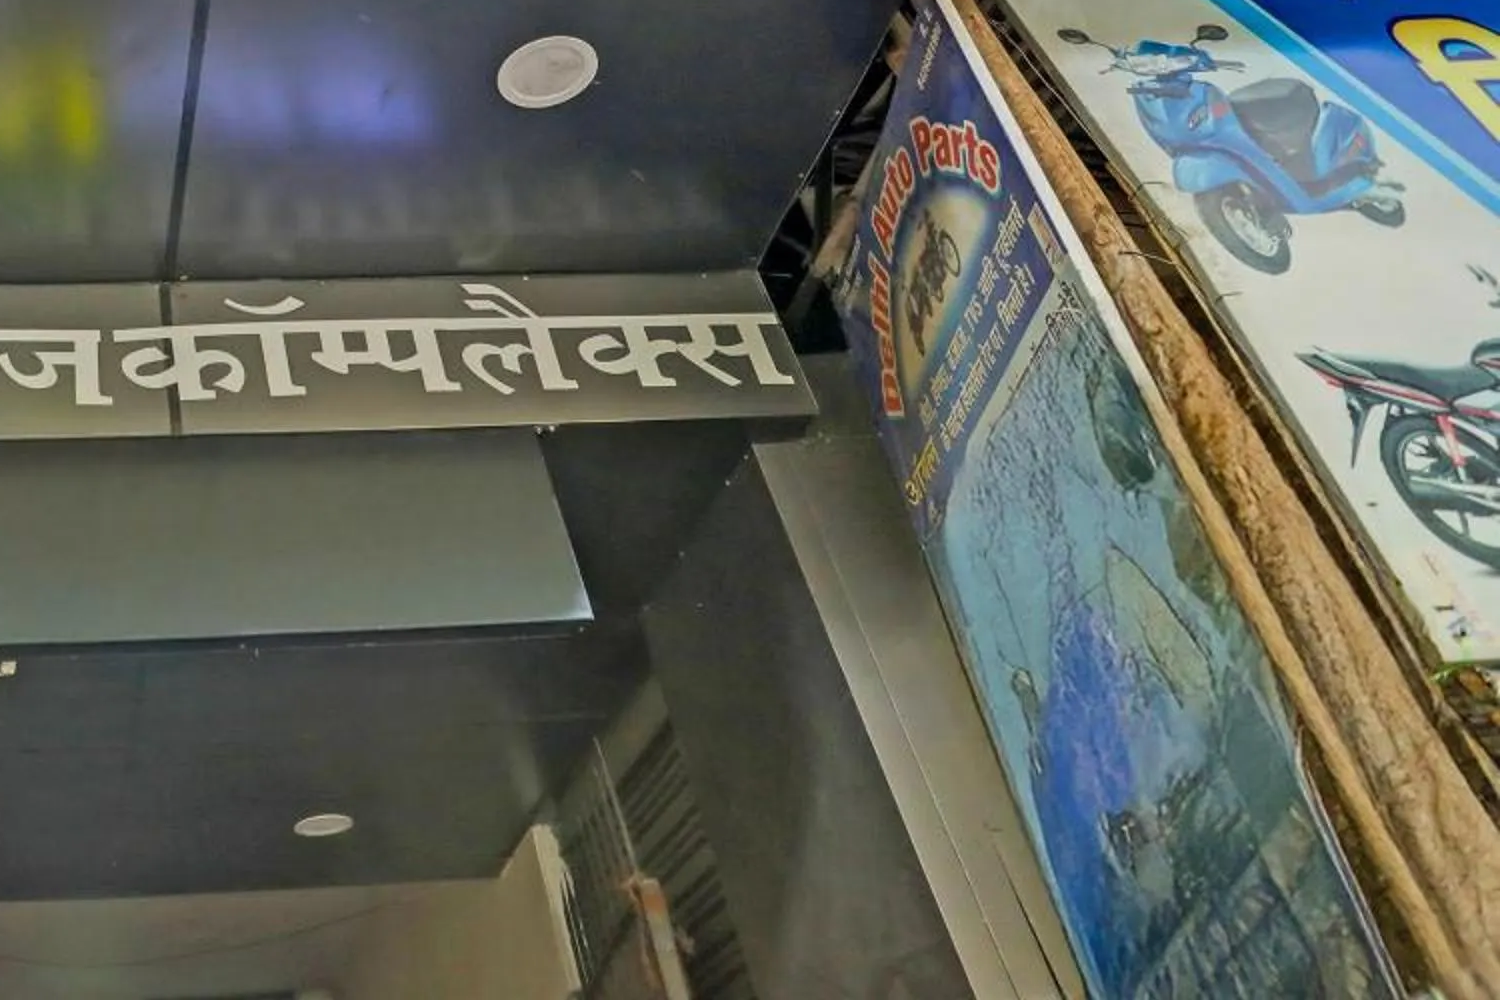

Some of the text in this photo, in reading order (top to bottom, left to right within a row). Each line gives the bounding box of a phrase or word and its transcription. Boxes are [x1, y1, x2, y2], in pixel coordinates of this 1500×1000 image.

[871, 146, 914, 264] Auto
[909, 115, 1000, 194] Parts
[867, 250, 904, 418] Delhi
